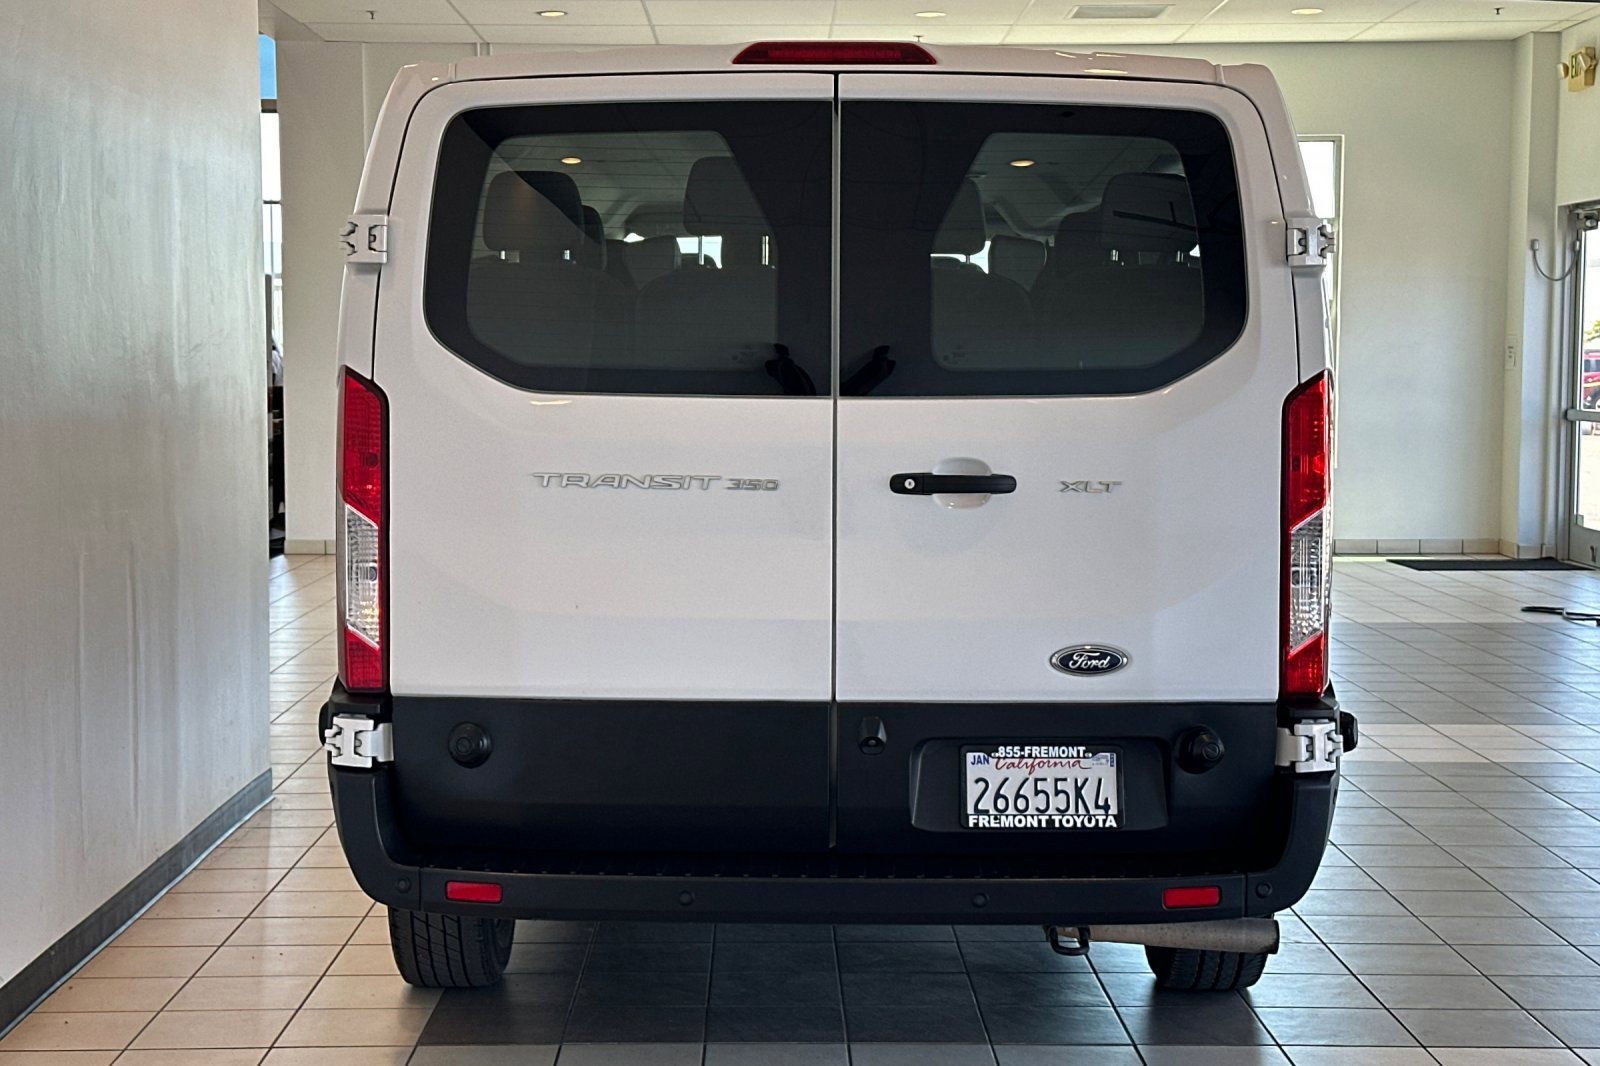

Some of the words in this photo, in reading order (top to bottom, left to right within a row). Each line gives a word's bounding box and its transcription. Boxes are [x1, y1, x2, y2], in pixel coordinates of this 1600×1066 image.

[532, 472, 721, 491] TRANSIT
[725, 478, 780, 491] 350
[1058, 480, 1123, 493] XLT
[1068, 652, 1111, 669] Ford
[998, 746, 1086, 758] 855-FREMONT
[970, 755, 990, 765] JAN
[995, 758, 1092, 775] California
[973, 777, 1111, 814] 26655K4
[968, 815, 1049, 828] FREMONT
[1052, 815, 1117, 828] TOYOTA
